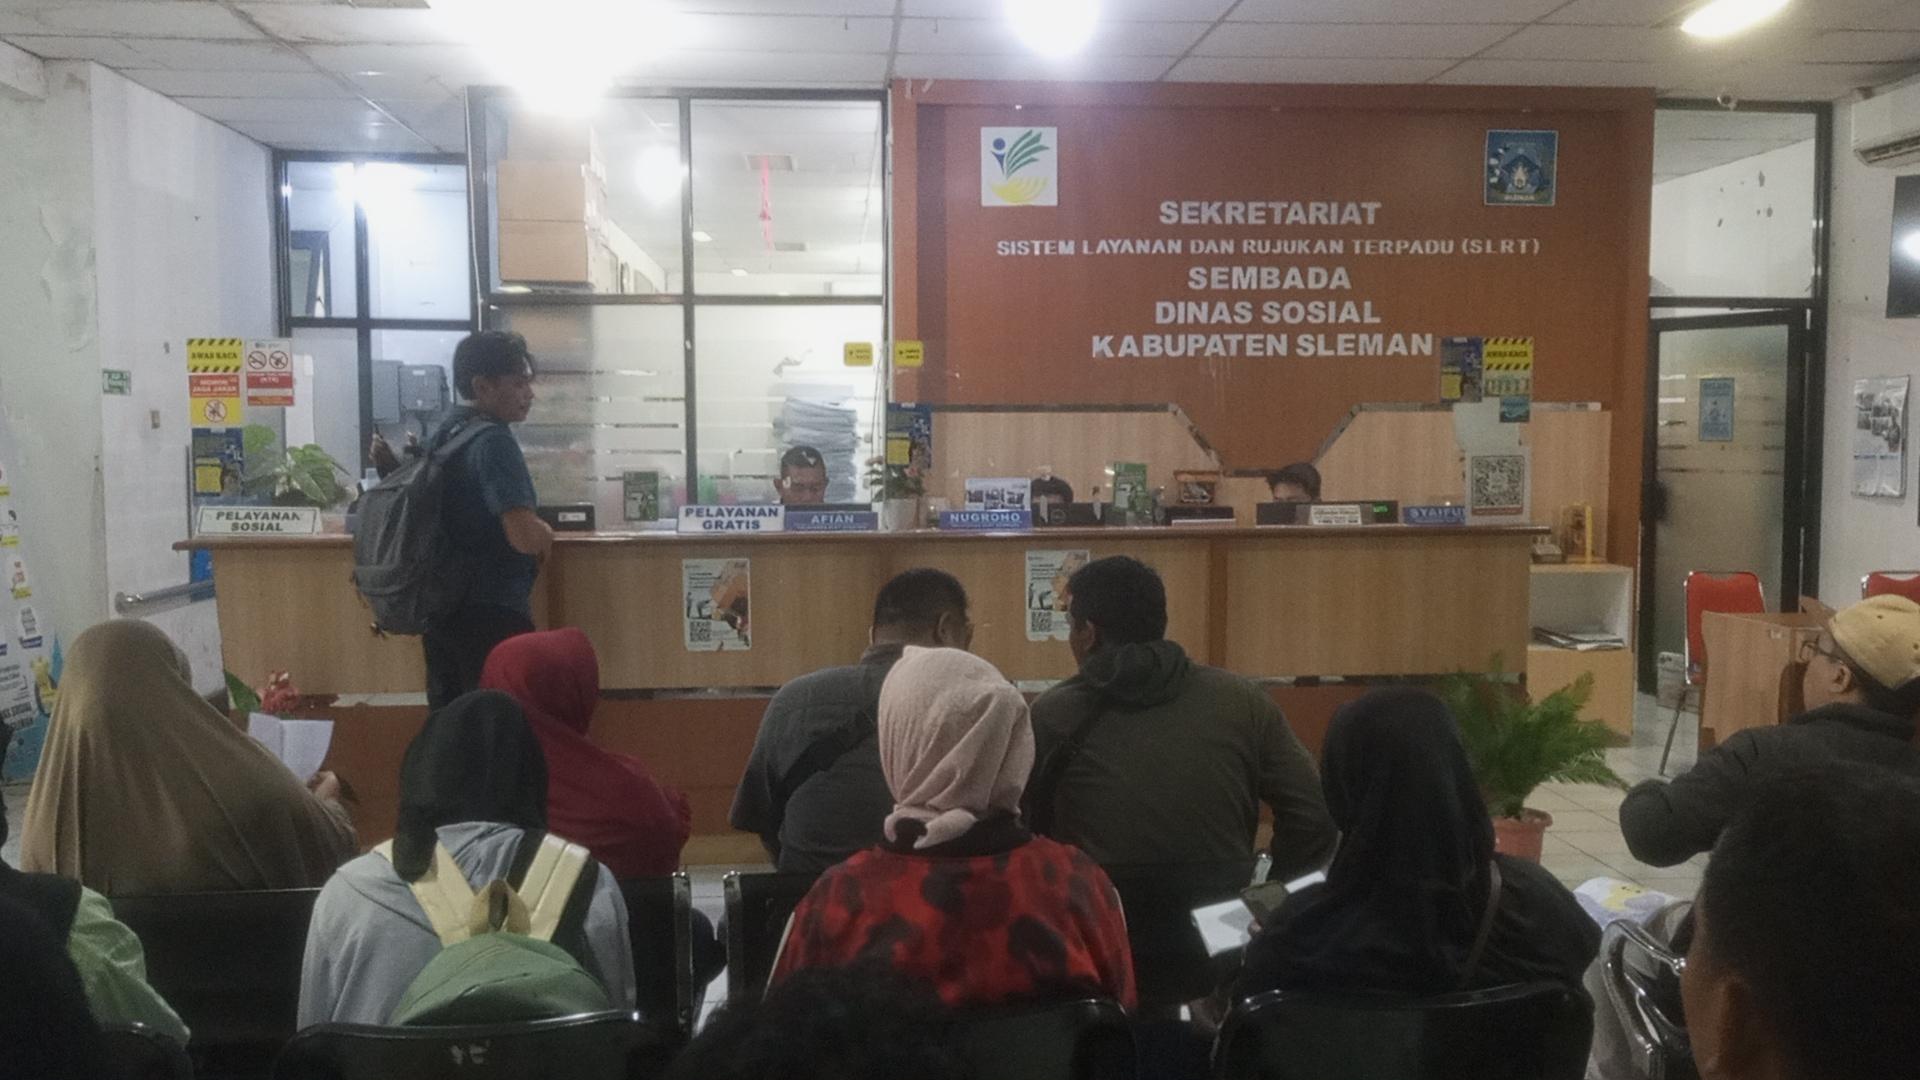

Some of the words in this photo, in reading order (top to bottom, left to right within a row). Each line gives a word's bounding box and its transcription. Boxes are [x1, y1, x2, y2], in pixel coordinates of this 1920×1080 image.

[1159, 201, 1382, 226] SEKRETARIAT
[996, 239, 1076, 256] SISTEM
[1082, 238, 1183, 255] LAYANAN
[1189, 238, 1235, 255] DAN
[1242, 238, 1345, 255] RUJUKAN
[1352, 238, 1455, 255] TERPADU
[1188, 266, 1352, 290] SEMBADA
[1155, 301, 1254, 325] DINAS
[1261, 301, 1381, 324] SOSIAL
[1092, 333, 1288, 358] KABUPATEN
[1296, 333, 1433, 357] SLEMAN
[215, 511, 300, 521] PELAYANAN
[685, 507, 779, 517] PELAYANAN
[950, 512, 1020, 522] NUGROHO
[811, 514, 854, 524] AFIAN
[231, 522, 284, 531] SOSIAL
[702, 520, 760, 530] GRATIS
